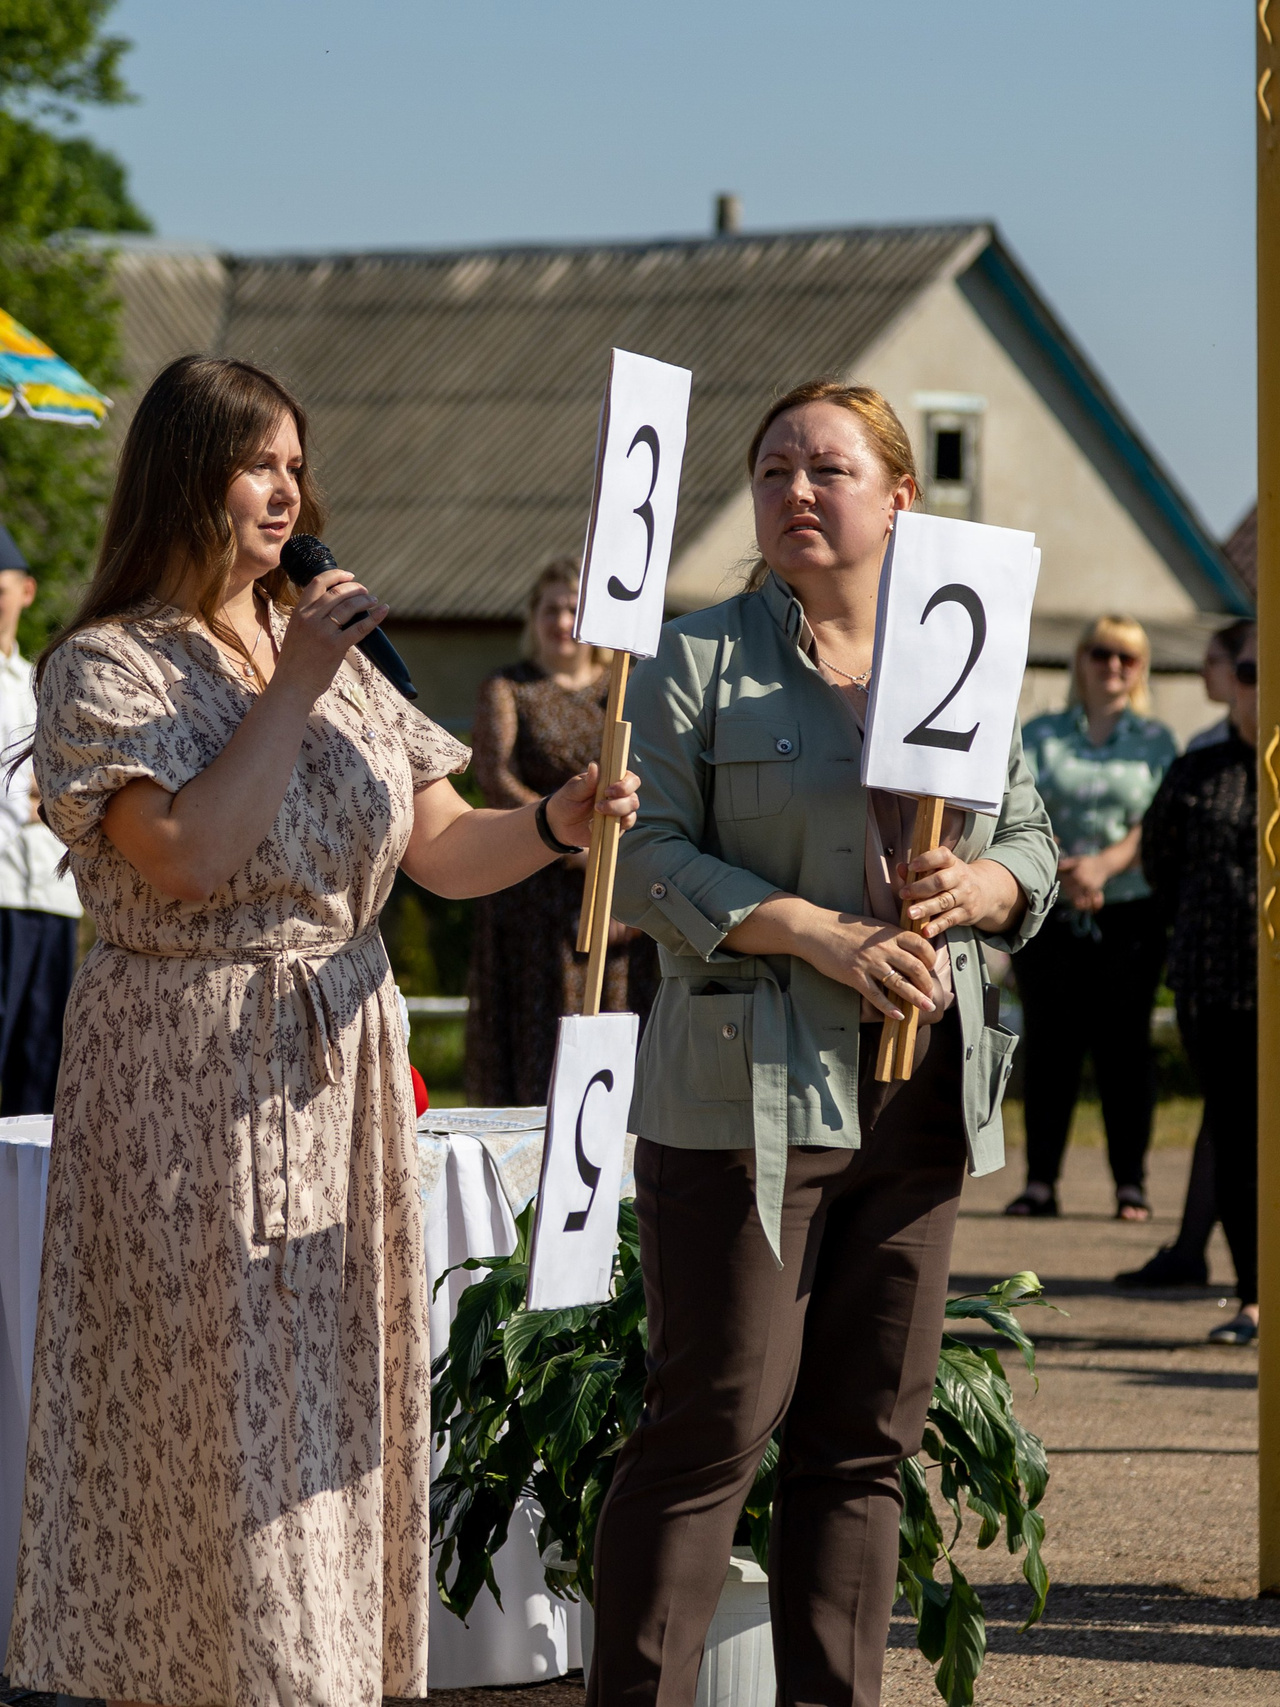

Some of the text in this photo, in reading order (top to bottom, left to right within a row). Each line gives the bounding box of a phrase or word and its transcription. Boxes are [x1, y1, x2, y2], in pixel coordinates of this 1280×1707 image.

[607, 424, 661, 602] 3
[902, 583, 987, 752] 2
[562, 1069, 614, 1232] 5
